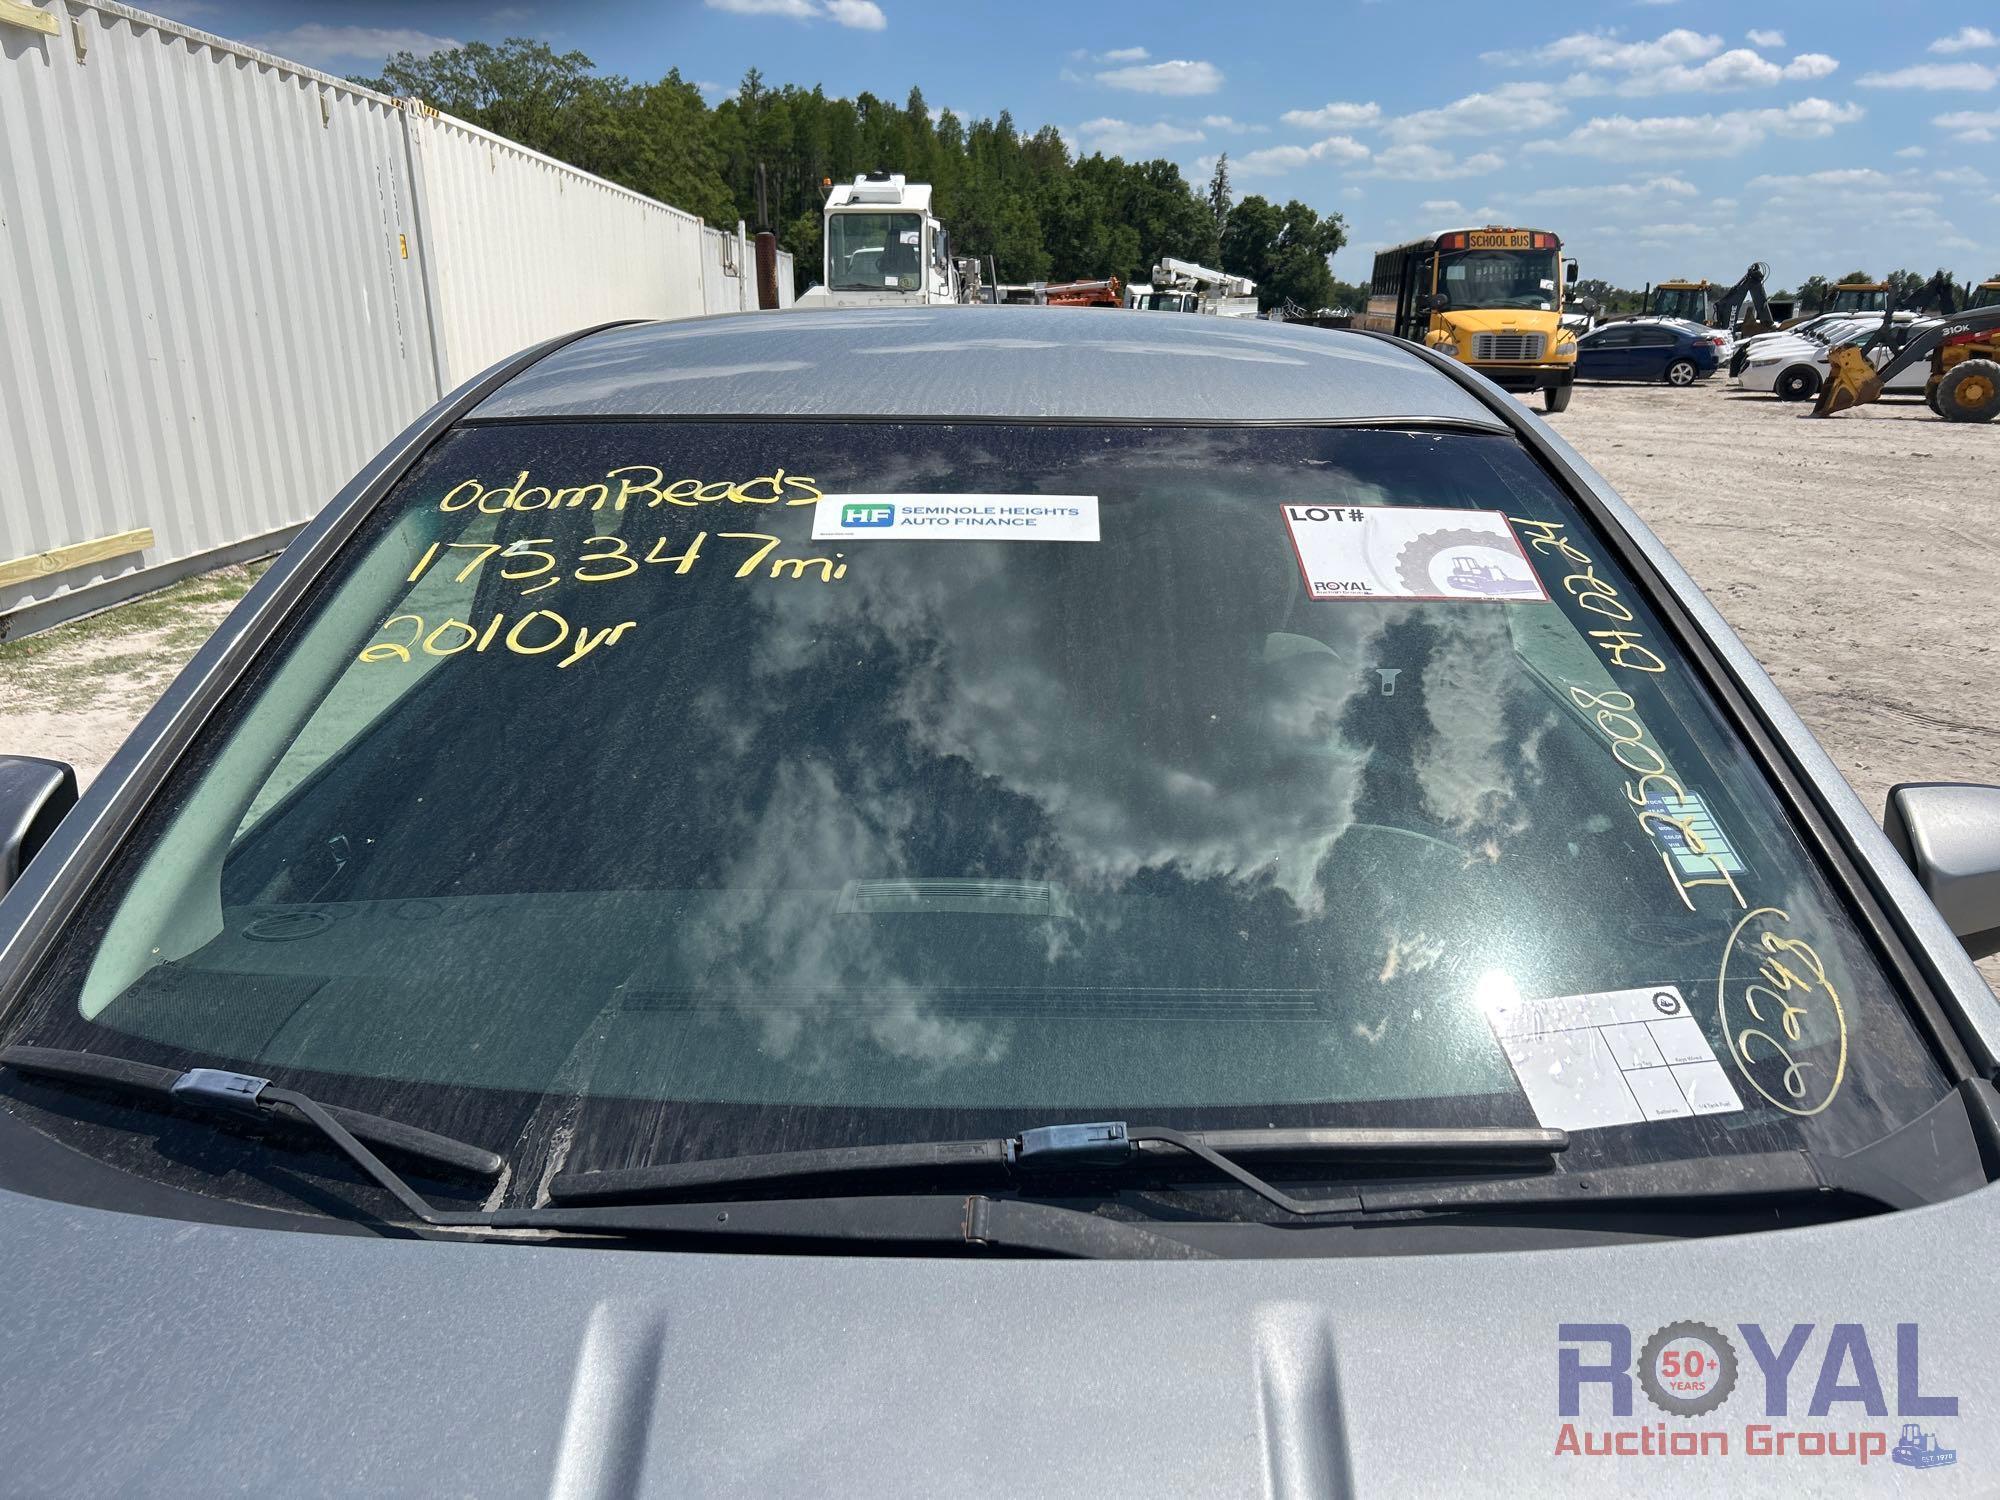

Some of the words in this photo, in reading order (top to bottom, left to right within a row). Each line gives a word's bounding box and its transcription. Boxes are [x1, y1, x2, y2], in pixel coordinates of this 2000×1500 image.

[1470, 235, 1507, 247] SCHOOL
[1510, 235, 1529, 247] BUS
[1942, 324, 1969, 336] 310K
[844, 508, 892, 523] HF
[901, 506, 996, 516] SEMINOLE
[1000, 507, 1080, 516] HEIGHTS
[901, 517, 950, 526] AUTO
[955, 517, 1037, 527] FINANCE
